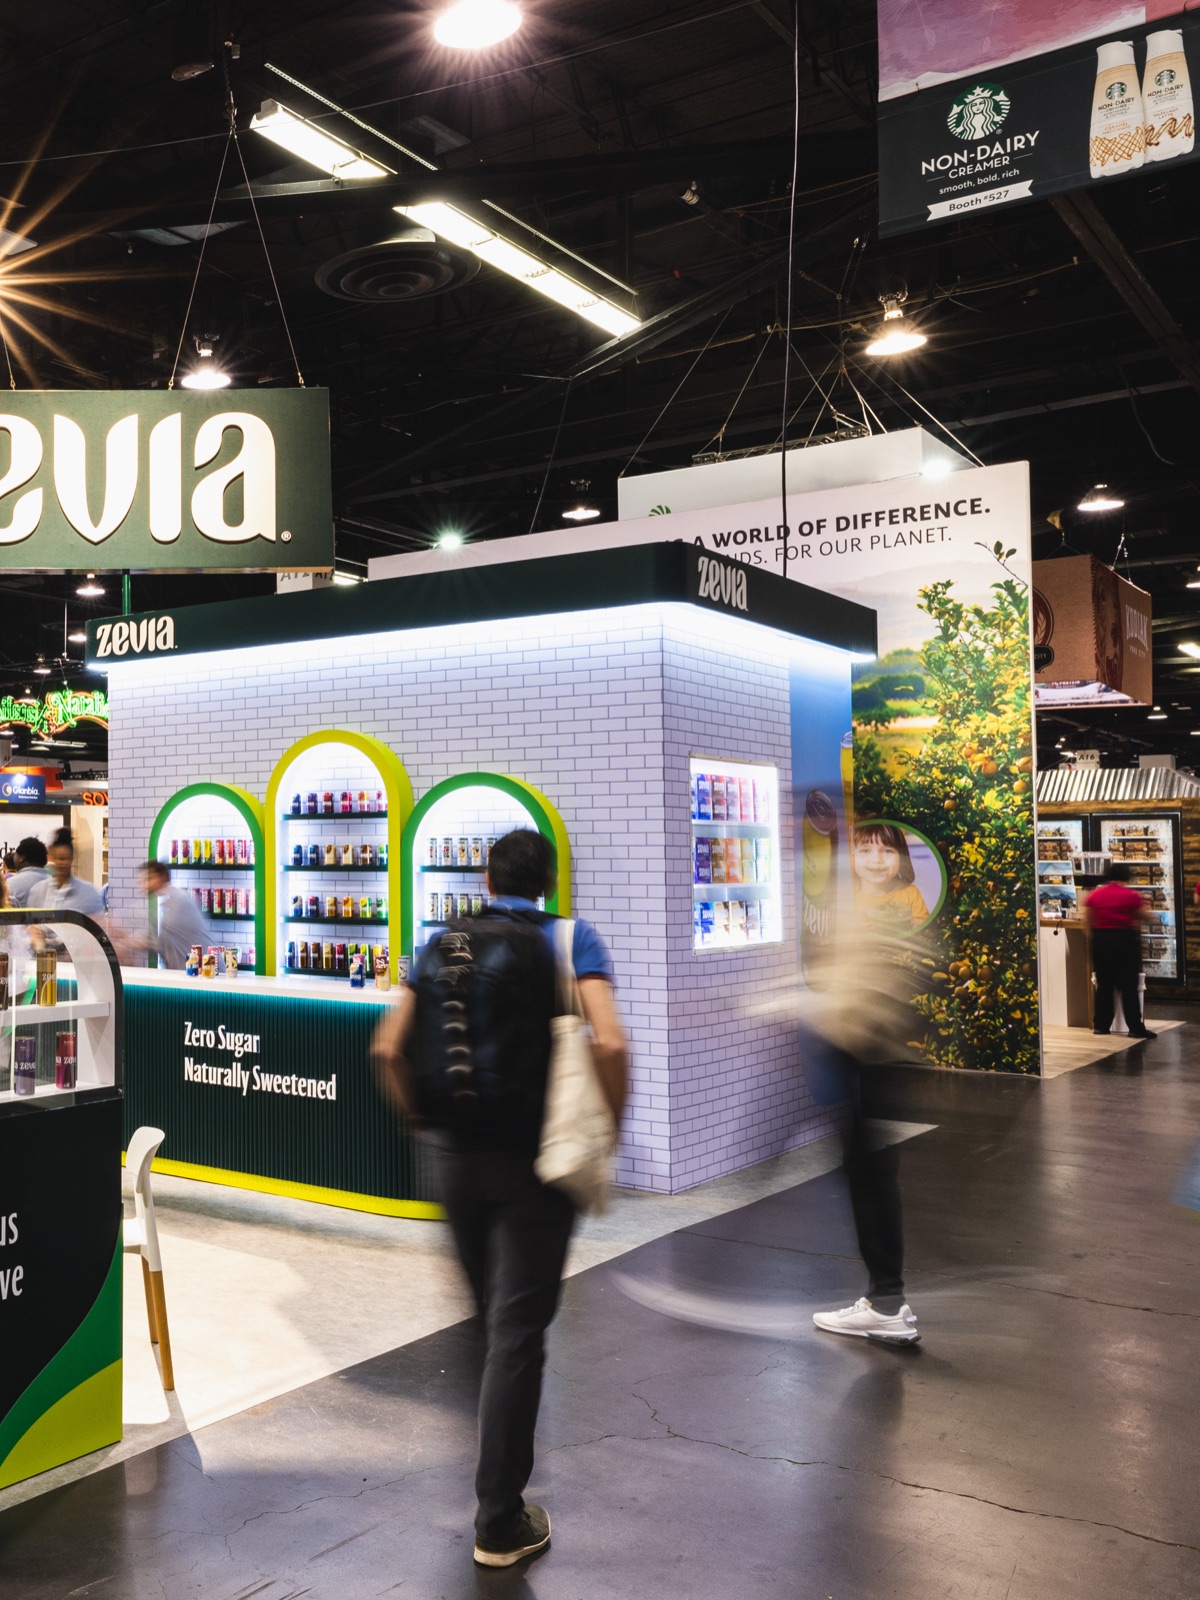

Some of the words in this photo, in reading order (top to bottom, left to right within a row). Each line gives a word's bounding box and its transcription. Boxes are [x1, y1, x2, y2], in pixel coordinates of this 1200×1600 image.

[921, 131, 1039, 175] NON-DAIRY
[948, 156, 1010, 180] CREAMER
[939, 178, 975, 195] smooth,
[977, 174, 1000, 187] bold,
[1002, 168, 1020, 181] rich
[949, 197, 982, 212] Booth
[983, 190, 1009, 204] #527
[712, 524, 790, 548] WORLD
[798, 517, 830, 537] OF
[835, 497, 991, 533] DIFFERENCE.
[775, 544, 812, 562] FOR
[820, 535, 862, 558] OUR
[870, 526, 952, 551] PLANET.
[1079, 753, 1095, 762] A16
[184, 1022, 215, 1048] Zero
[217, 1025, 260, 1057] Sugar
[184, 1057, 250, 1096] Naturally
[252, 1065, 337, 1101] Sweetened
